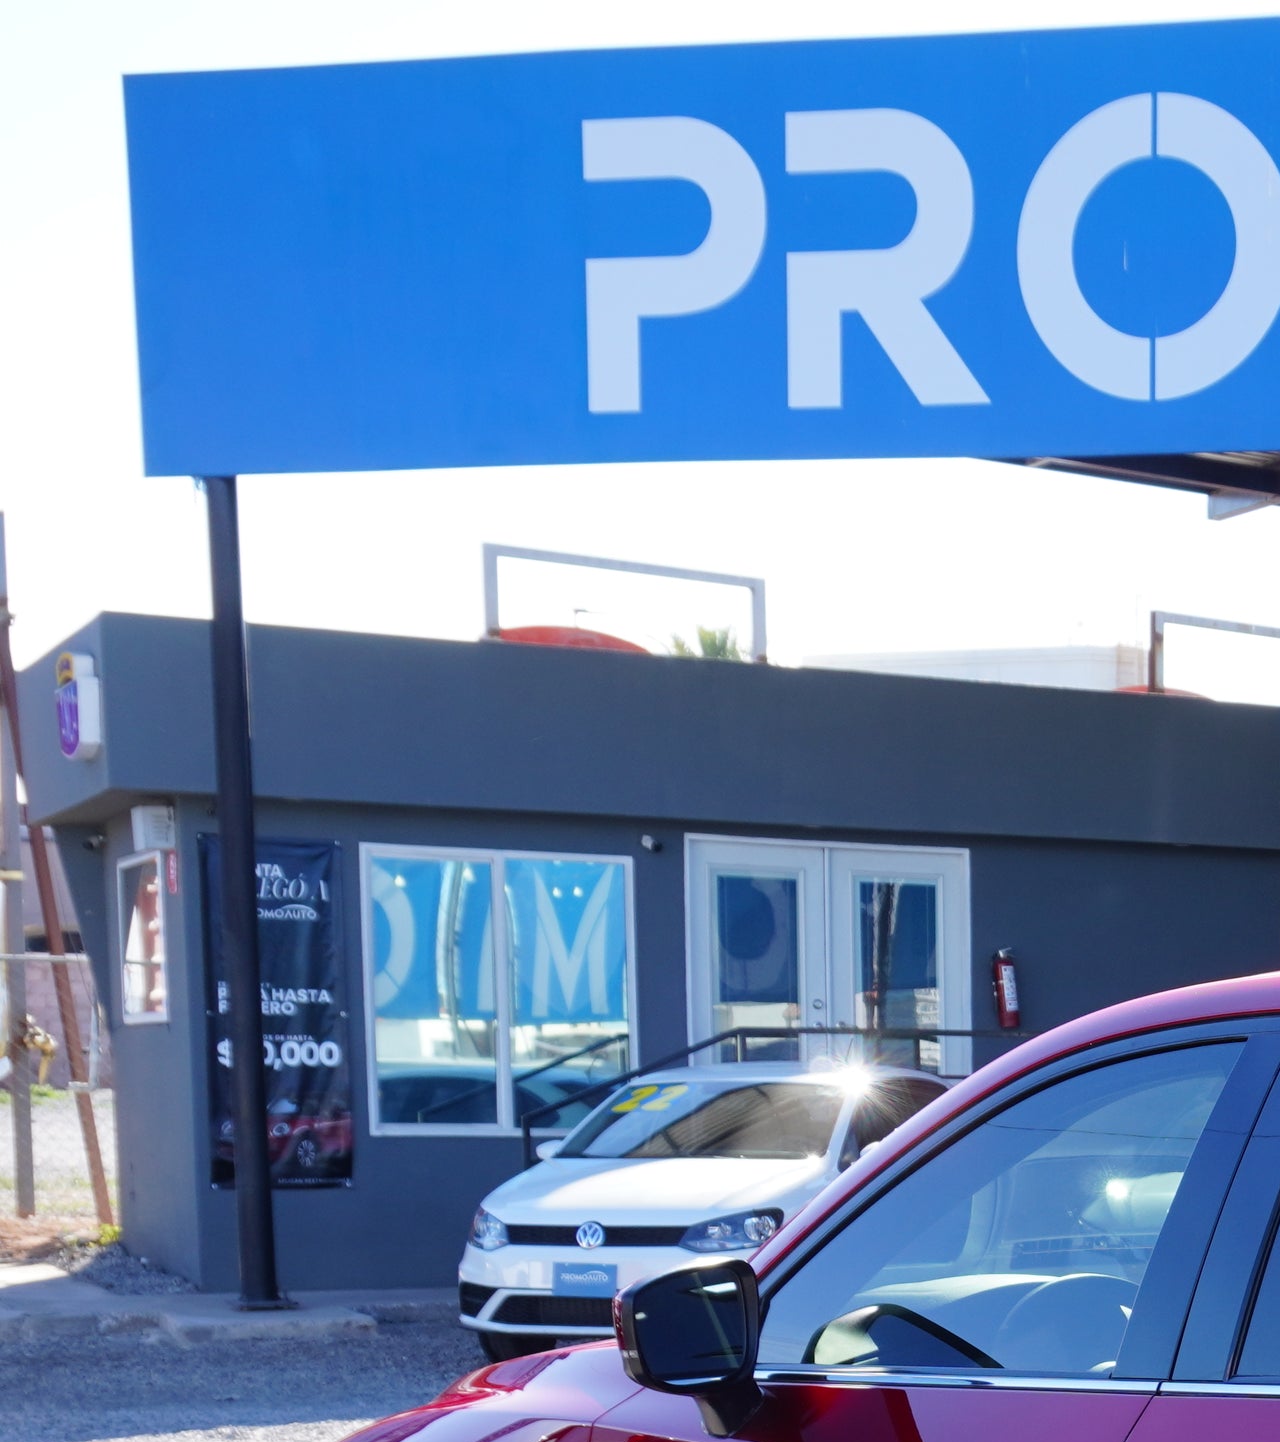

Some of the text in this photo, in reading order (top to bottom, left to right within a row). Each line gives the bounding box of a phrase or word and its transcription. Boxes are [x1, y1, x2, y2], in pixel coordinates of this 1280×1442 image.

[255, 863, 283, 877] NTA
[271, 987, 332, 1003] HASTA
[218, 1000, 296, 1016] FERO
[611, 1084, 689, 1113] 22
